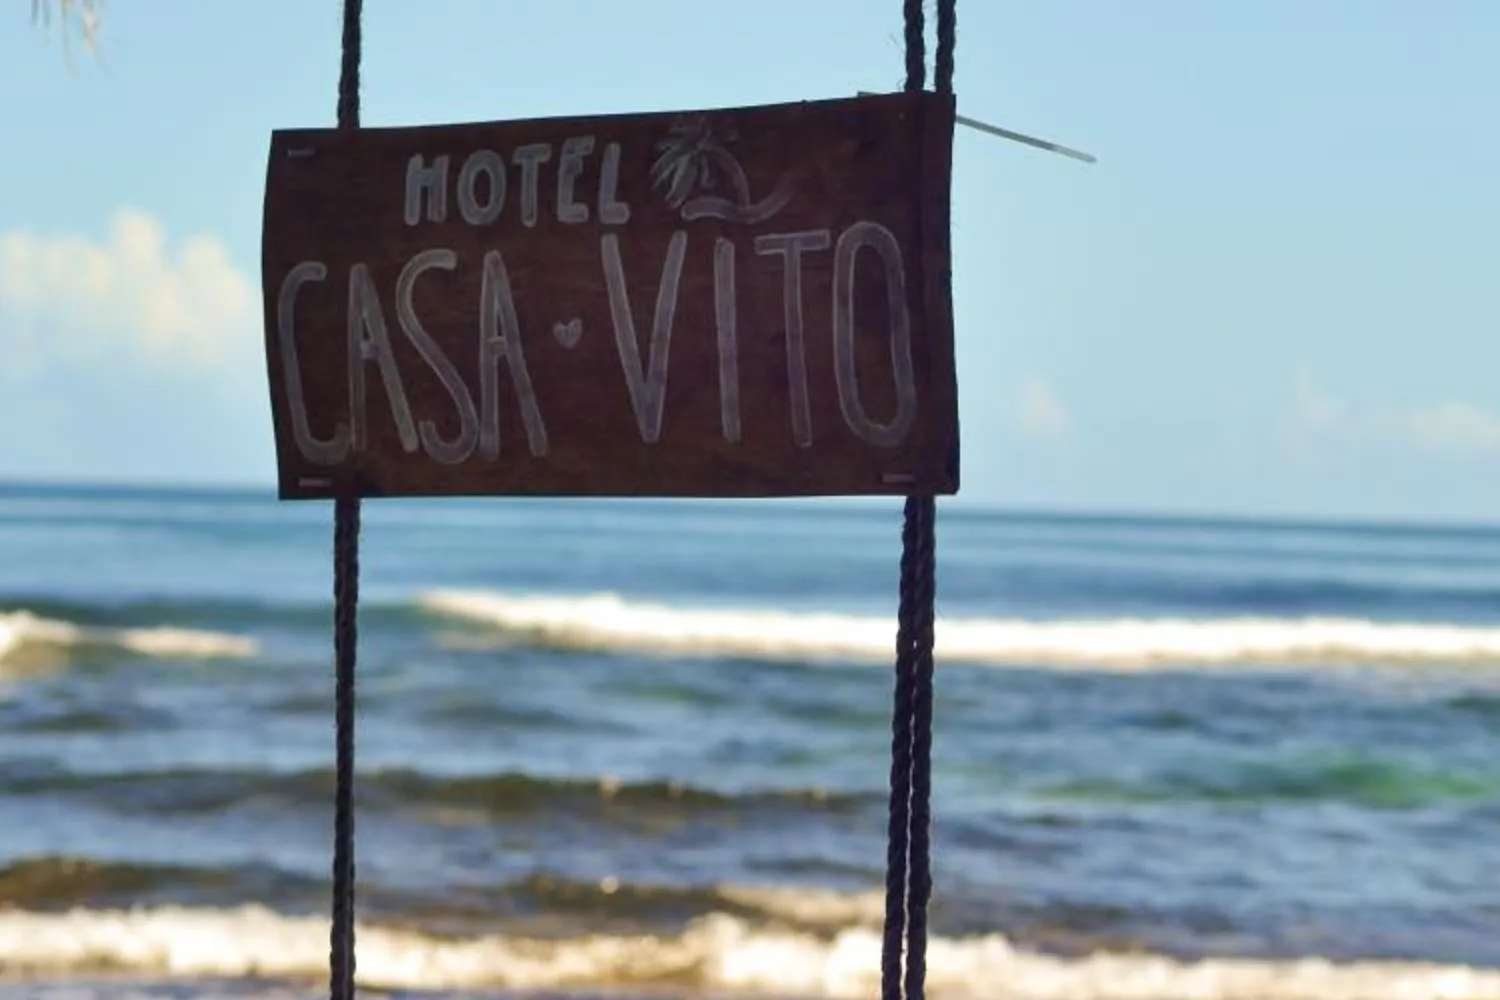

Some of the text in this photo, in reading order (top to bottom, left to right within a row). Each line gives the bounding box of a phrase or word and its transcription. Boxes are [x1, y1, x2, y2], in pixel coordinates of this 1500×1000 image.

[403, 136, 631, 227] HOTEL
[278, 221, 917, 464] CASA VITO
